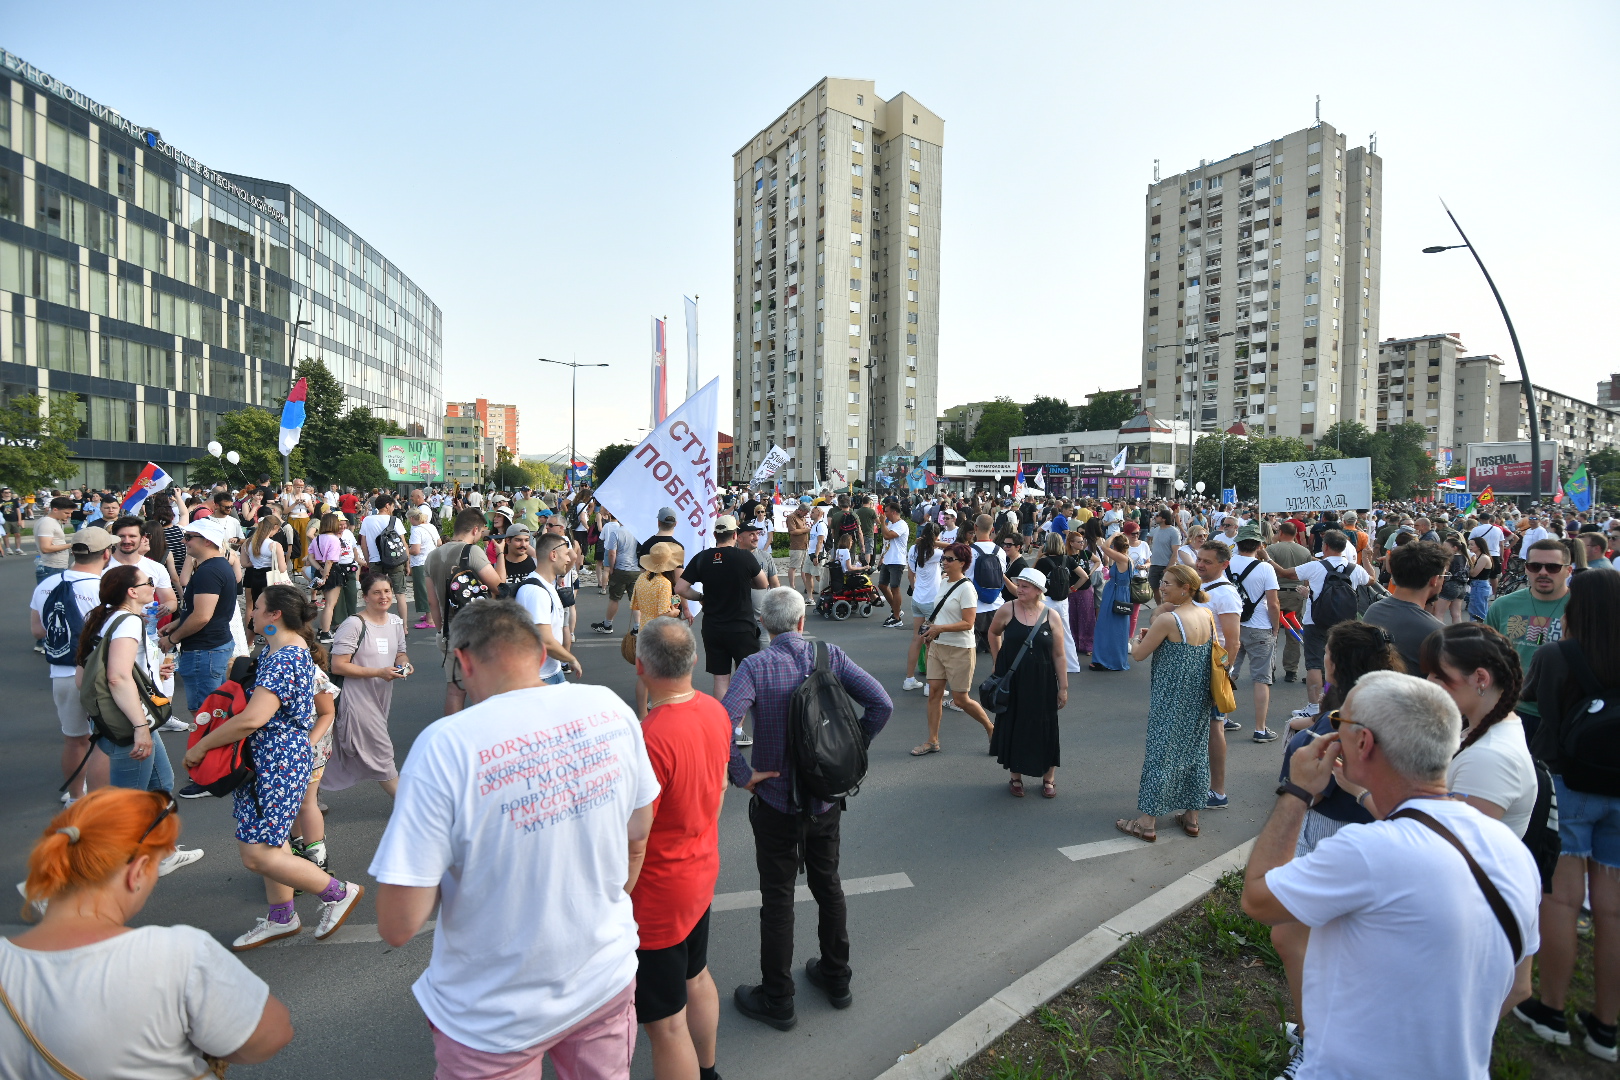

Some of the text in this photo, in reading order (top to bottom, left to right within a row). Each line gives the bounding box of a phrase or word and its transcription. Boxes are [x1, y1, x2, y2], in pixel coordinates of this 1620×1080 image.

[112, 112, 146, 143] ПАРК
[156, 139, 285, 225] SCIENCE & TECHNOLOGY PARK
[1294, 462, 1337, 478] САД
[1475, 453, 1519, 467] ARSENAL
[1475, 465, 1499, 477] FEST
[1285, 494, 1348, 511] НИКАД
[478, 734, 531, 766] BORN
[534, 728, 552, 744] IN
[553, 719, 586, 739] THE
[520, 728, 587, 756] COVER ME
[480, 741, 611, 796] DOWNBOUND TRAIN
[485, 753, 549, 783] WORKING
[551, 747, 569, 760] ON
[570, 738, 592, 754] THE
[526, 748, 611, 790] I'M ON FIRE
[559, 753, 619, 784] SURRENDER
[585, 767, 621, 792] DOWN
[501, 787, 547, 815] BOBBY
[524, 788, 617, 835] MY HOMETOWN
